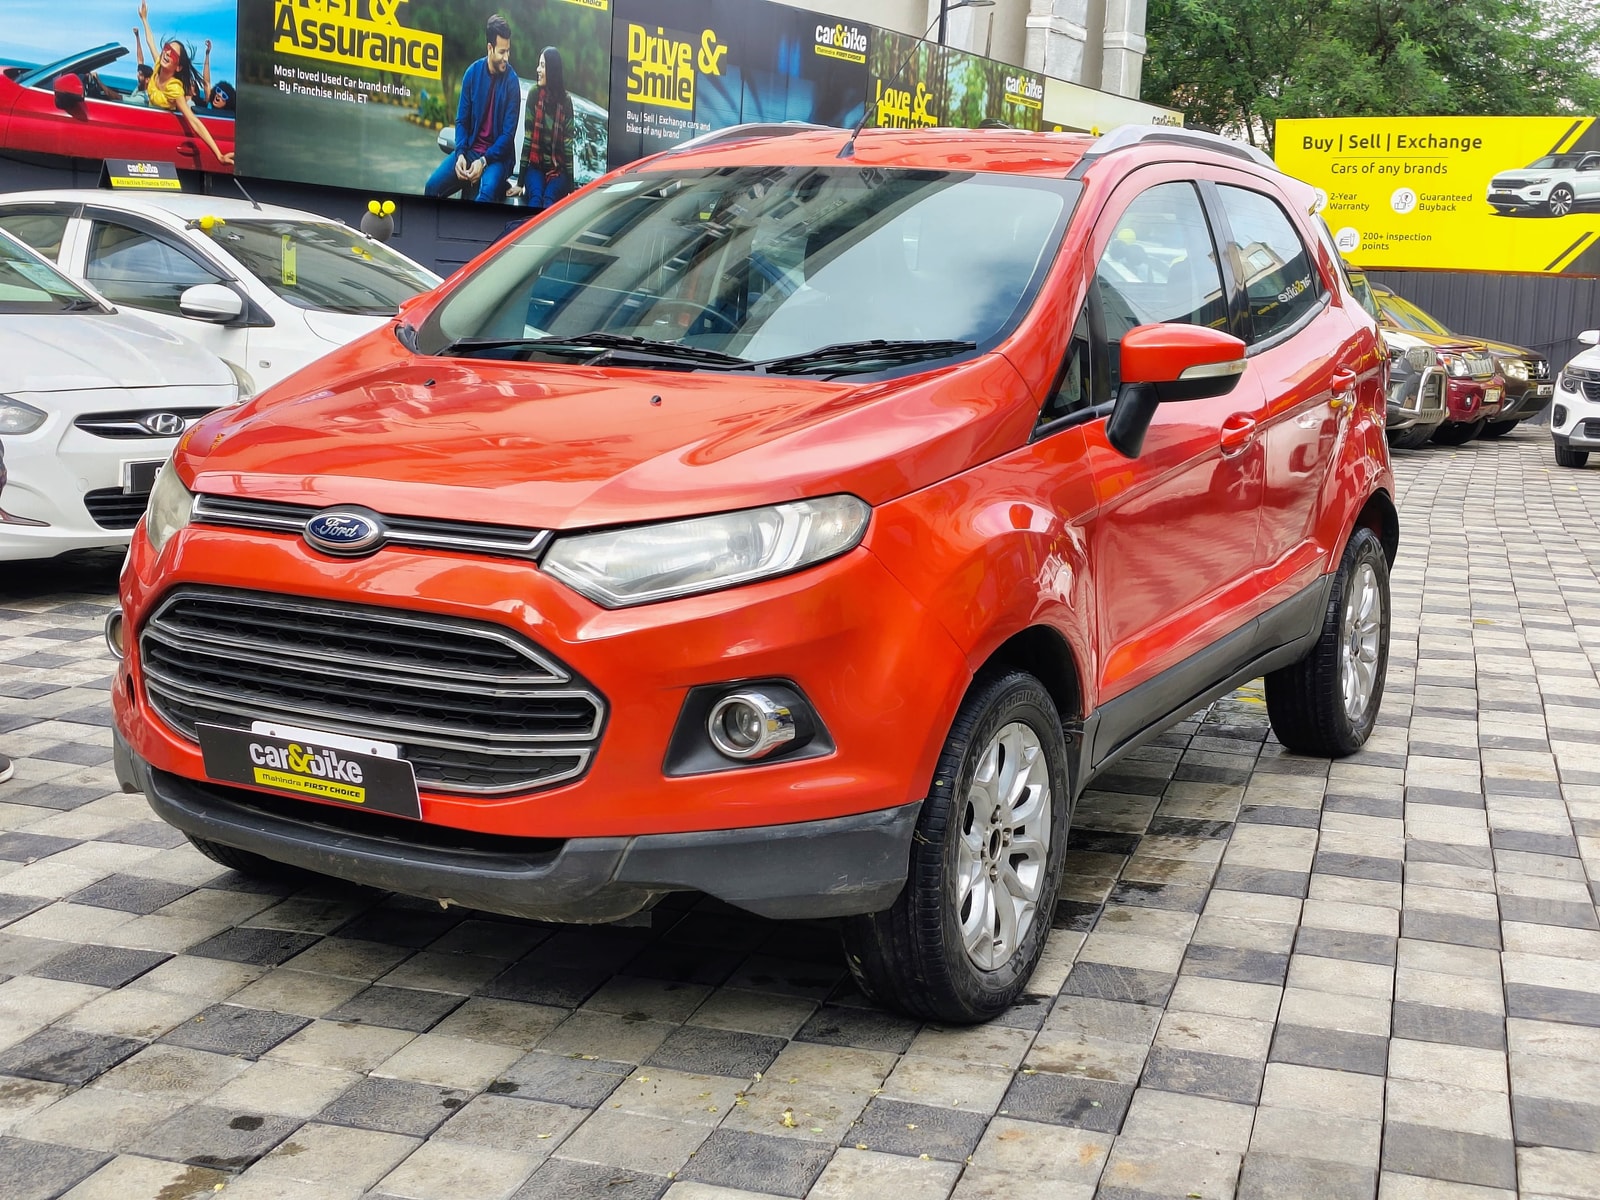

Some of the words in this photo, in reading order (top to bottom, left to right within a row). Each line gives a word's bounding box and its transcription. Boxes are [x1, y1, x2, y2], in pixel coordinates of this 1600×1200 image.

[274, 4, 439, 72] Assurance
[815, 24, 867, 52] car&bike
[628, 23, 692, 68] Drive
[697, 29, 728, 76] &
[274, 64, 296, 78] Most
[297, 68, 320, 82] loved
[321, 73, 342, 86] Used
[343, 77, 357, 87] Car
[358, 78, 381, 92] brand
[382, 83, 391, 94] of
[392, 84, 411, 97] India
[627, 59, 692, 104] Smile
[279, 81, 291, 94] By
[292, 83, 332, 99] Franchise
[334, 89, 356, 104] India,
[357, 94, 369, 104] ET
[876, 79, 911, 110] Love
[913, 81, 934, 115] &
[626, 110, 639, 122] Buy
[643, 113, 655, 123] Sell
[658, 115, 686, 129] Exchange
[687, 121, 699, 129] cars
[700, 122, 711, 131] and
[626, 122, 642, 134] bikes
[642, 126, 650, 135] of
[650, 129, 662, 138] any
[662, 127, 680, 139] brand
[1302, 136, 1334, 152] Buy
[1348, 133, 1381, 149] Sell
[1396, 133, 1482, 152] Exchange
[1331, 162, 1358, 174] Cars
[1361, 162, 1376, 174] of
[1378, 165, 1400, 176] any
[1404, 163, 1448, 174] brands
[1330, 192, 1357, 201] 2-Year
[1420, 193, 1473, 202] Guaranteed
[1329, 203, 1370, 212] Warranty
[1419, 203, 1457, 212] Buyback
[1362, 232, 1384, 241] 200+
[1386, 232, 1432, 242] inspection
[1362, 243, 1390, 251] points
[320, 517, 360, 538] Ford
[249, 742, 364, 784] car&bike
[262, 773, 302, 787] Mahindra
[304, 781, 328, 791] FIRST
[329, 786, 361, 798] CHOICE
